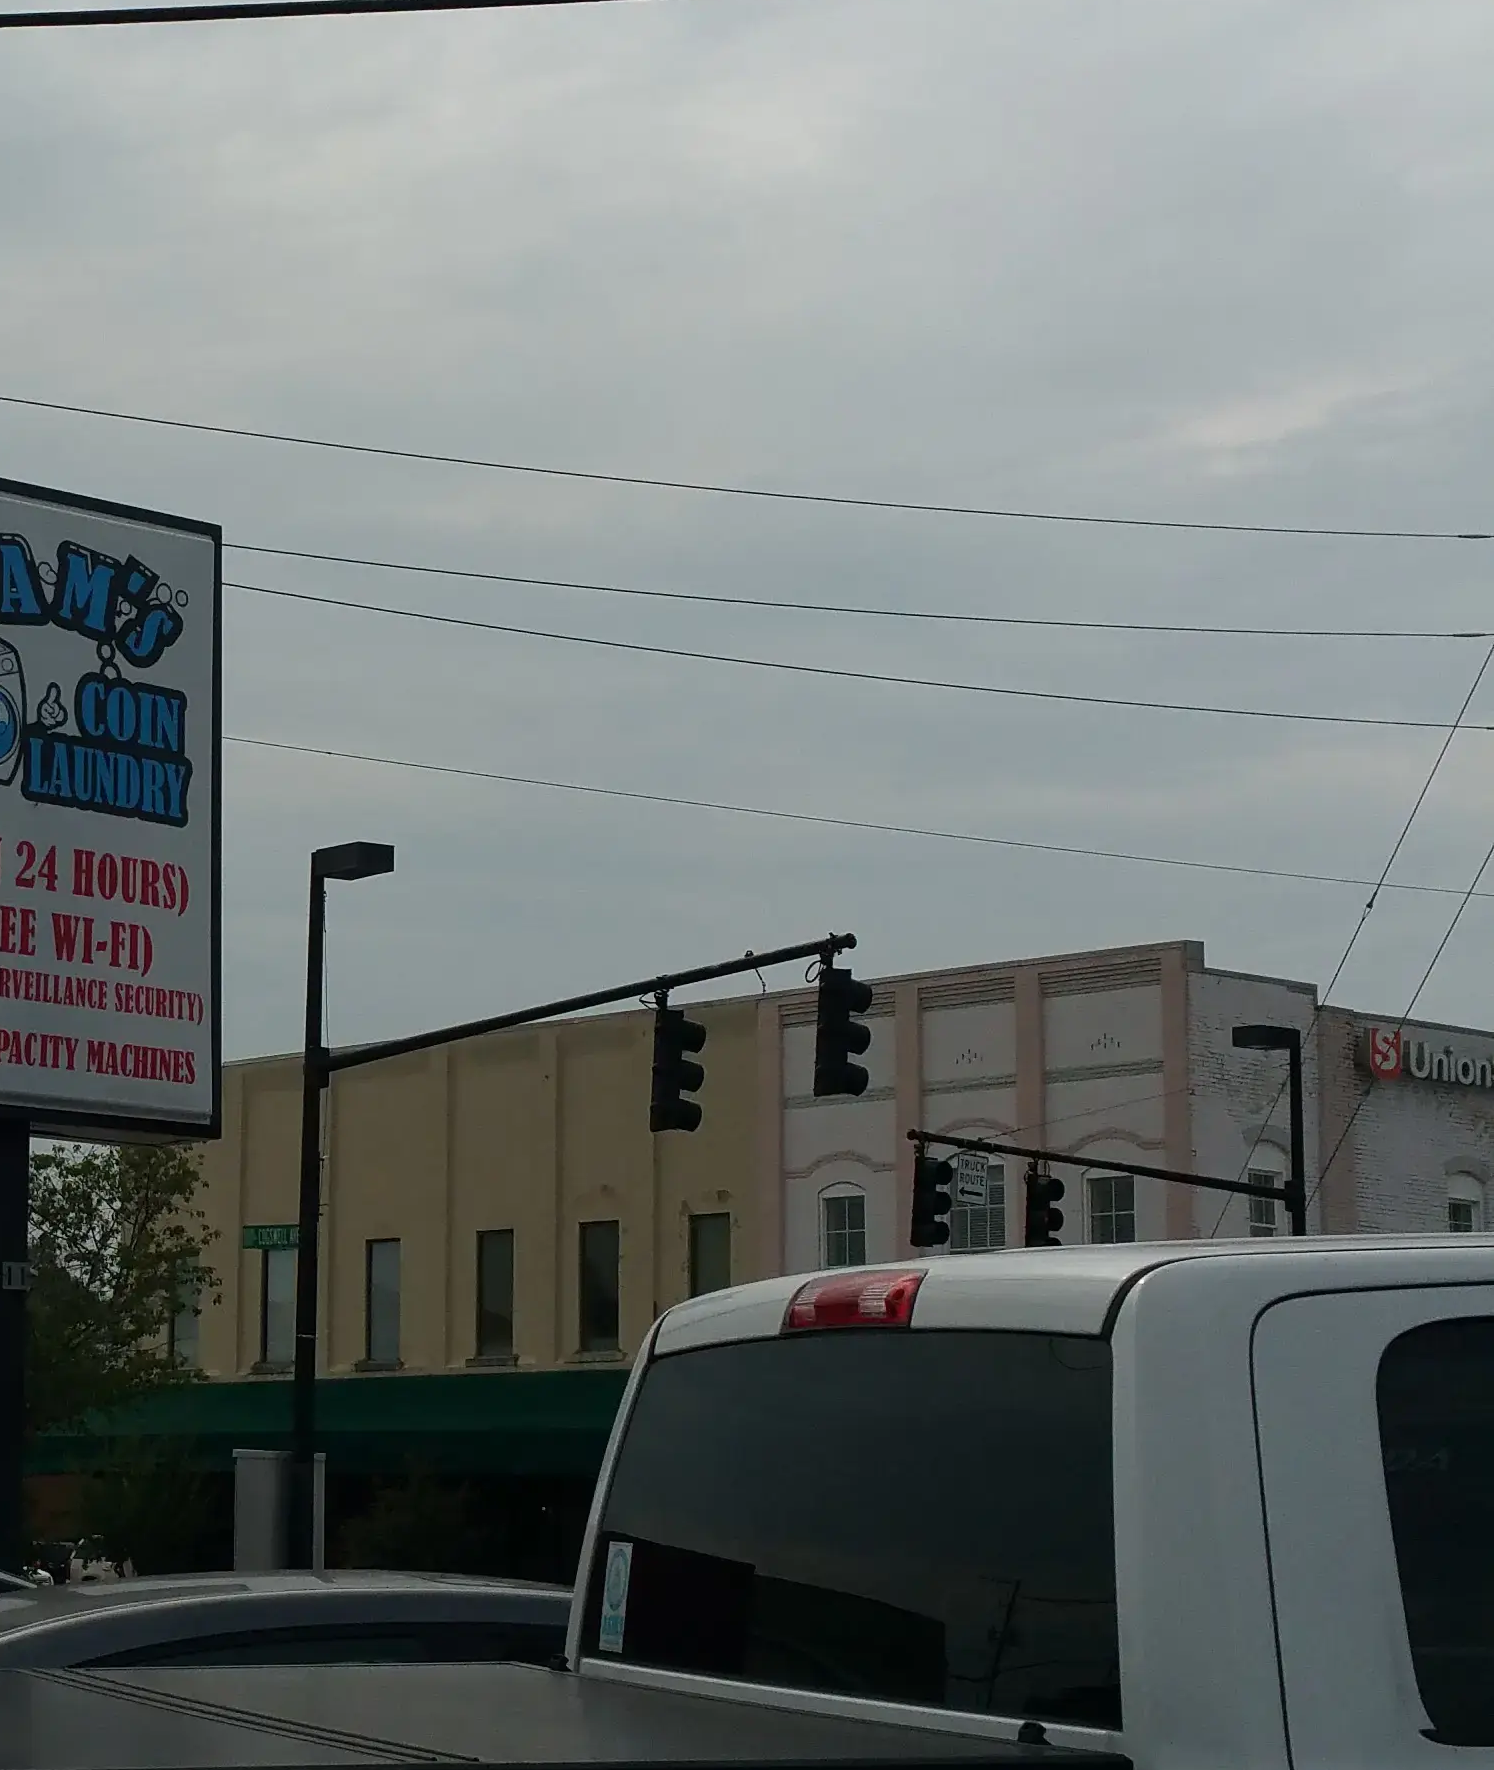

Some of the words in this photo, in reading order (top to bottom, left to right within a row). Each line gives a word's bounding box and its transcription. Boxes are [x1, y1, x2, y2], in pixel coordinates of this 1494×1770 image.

[80, 680, 181, 754] COIN
[28, 736, 187, 819] LAUNDRY
[14, 840, 59, 892] 24
[72, 848, 190, 917] HOURS)
[51, 912, 154, 978] WI-FI)
[113, 981, 205, 1026] SECURITY)
[85, 1039, 197, 1085] MACHINES
[1409, 1040, 1494, 1089] Union
[959, 1172, 985, 1187] ROUTE
[960, 1158, 986, 1173] TRUCK
